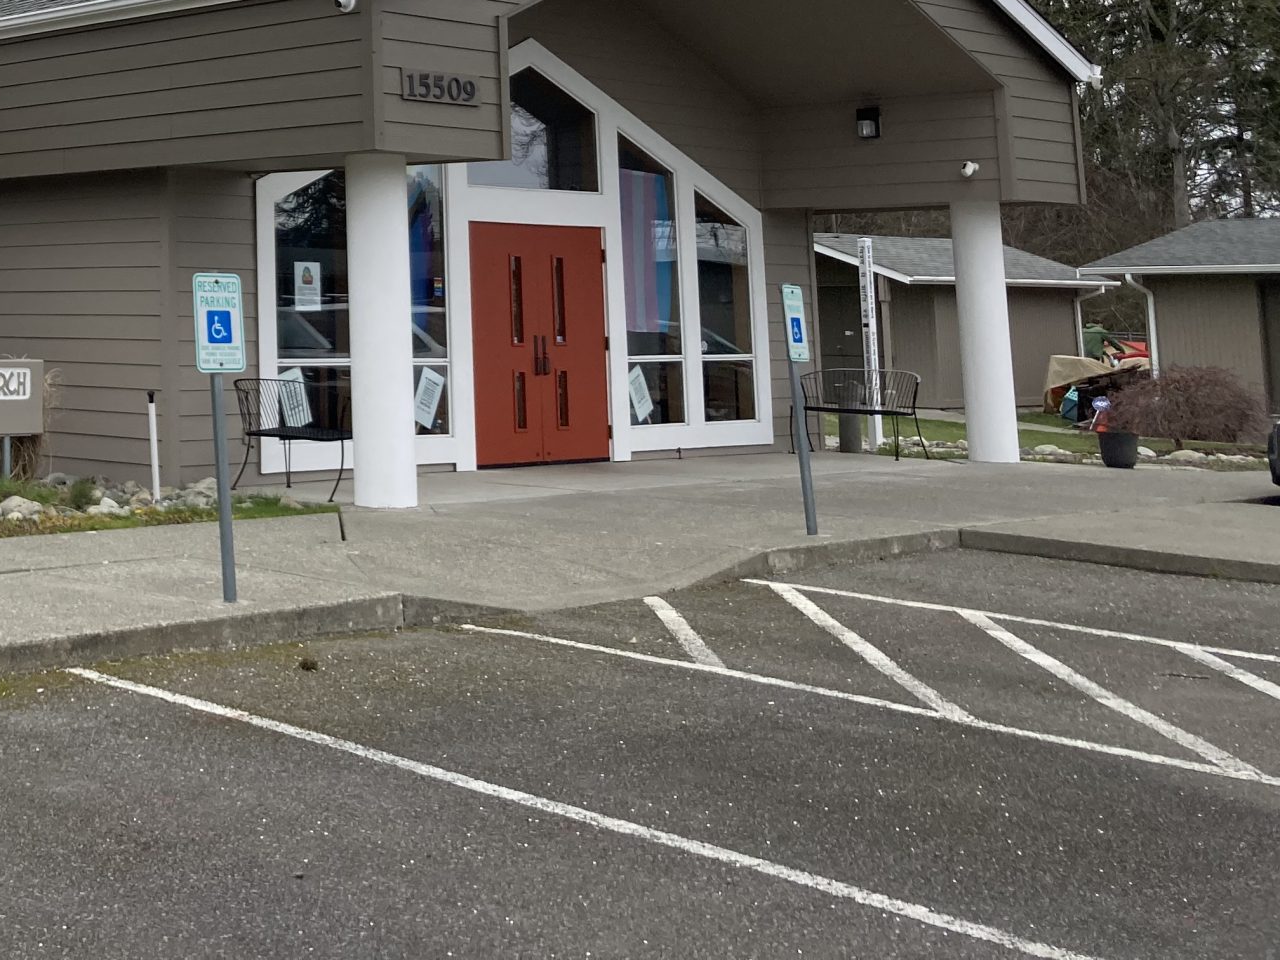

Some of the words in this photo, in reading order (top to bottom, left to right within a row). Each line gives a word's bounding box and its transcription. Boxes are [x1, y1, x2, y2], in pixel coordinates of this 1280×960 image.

[406, 73, 476, 102] 15509
[197, 280, 237, 294] RESERVED
[200, 295, 237, 309] PARKING
